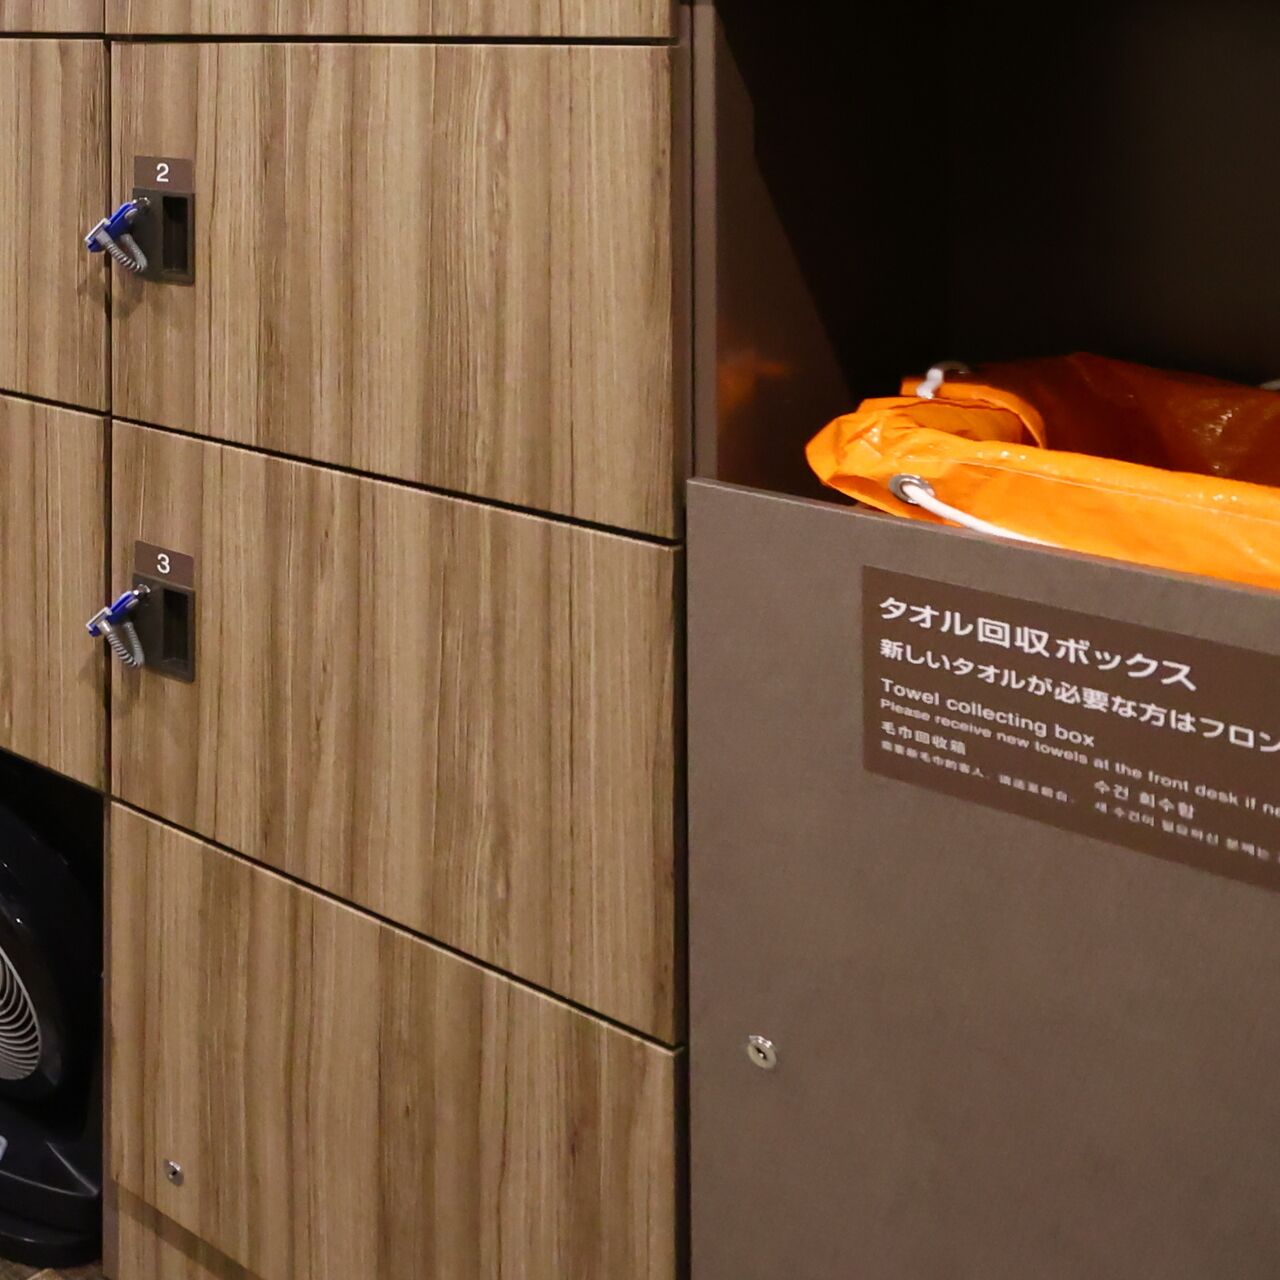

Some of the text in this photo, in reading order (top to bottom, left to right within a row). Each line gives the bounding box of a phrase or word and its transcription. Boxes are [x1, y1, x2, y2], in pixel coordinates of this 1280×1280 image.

[156, 163, 168, 182] 2
[156, 553, 171, 573] 3
[879, 597, 1196, 690] タオル回収ボックス
[881, 678, 1094, 747] Towel collecting box
[880, 698, 930, 721] Please
[934, 715, 991, 737] receive
[996, 732, 1029, 748] new
[1035, 741, 1087, 764] towels
[1093, 758, 1109, 770] at
[1115, 762, 1142, 779] the
[1148, 770, 1188, 792] front
[1195, 785, 1237, 805] desk
[1245, 797, 1255, 809] if
[1094, 780, 1128, 800] 수건
